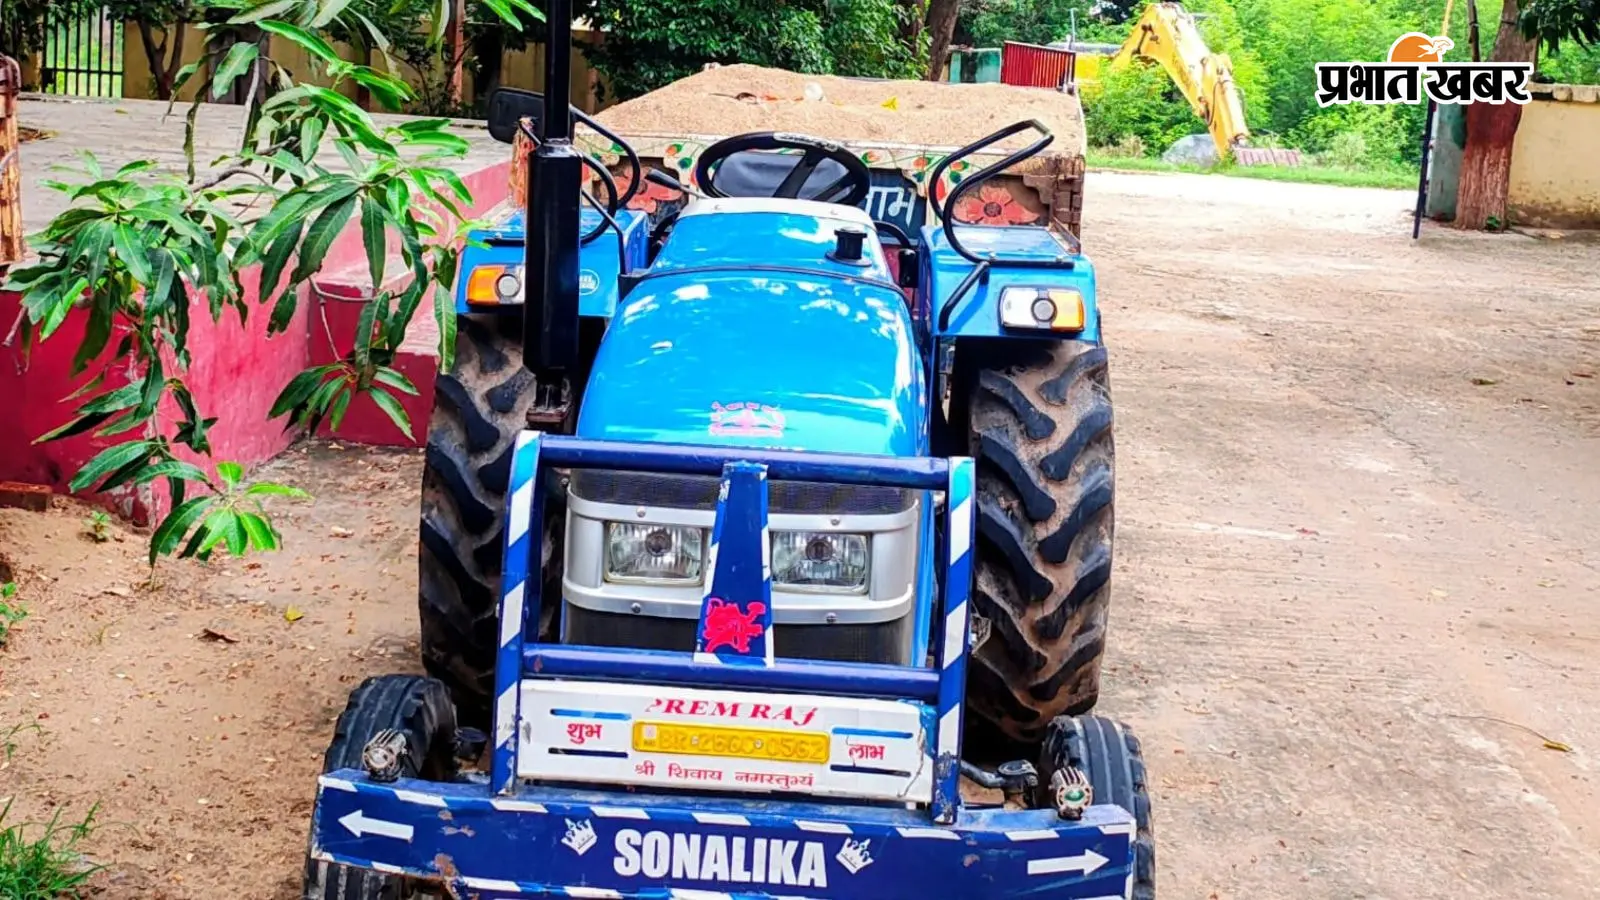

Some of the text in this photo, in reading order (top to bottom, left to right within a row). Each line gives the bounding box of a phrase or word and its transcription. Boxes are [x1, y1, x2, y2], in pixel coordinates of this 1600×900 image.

[566, 723, 603, 745] शुभ
[848, 743, 886, 761] लाभ
[634, 760, 815, 790] श्री शिवाय नमस्तुभ्यं
[613, 828, 828, 888] SONALIKA
